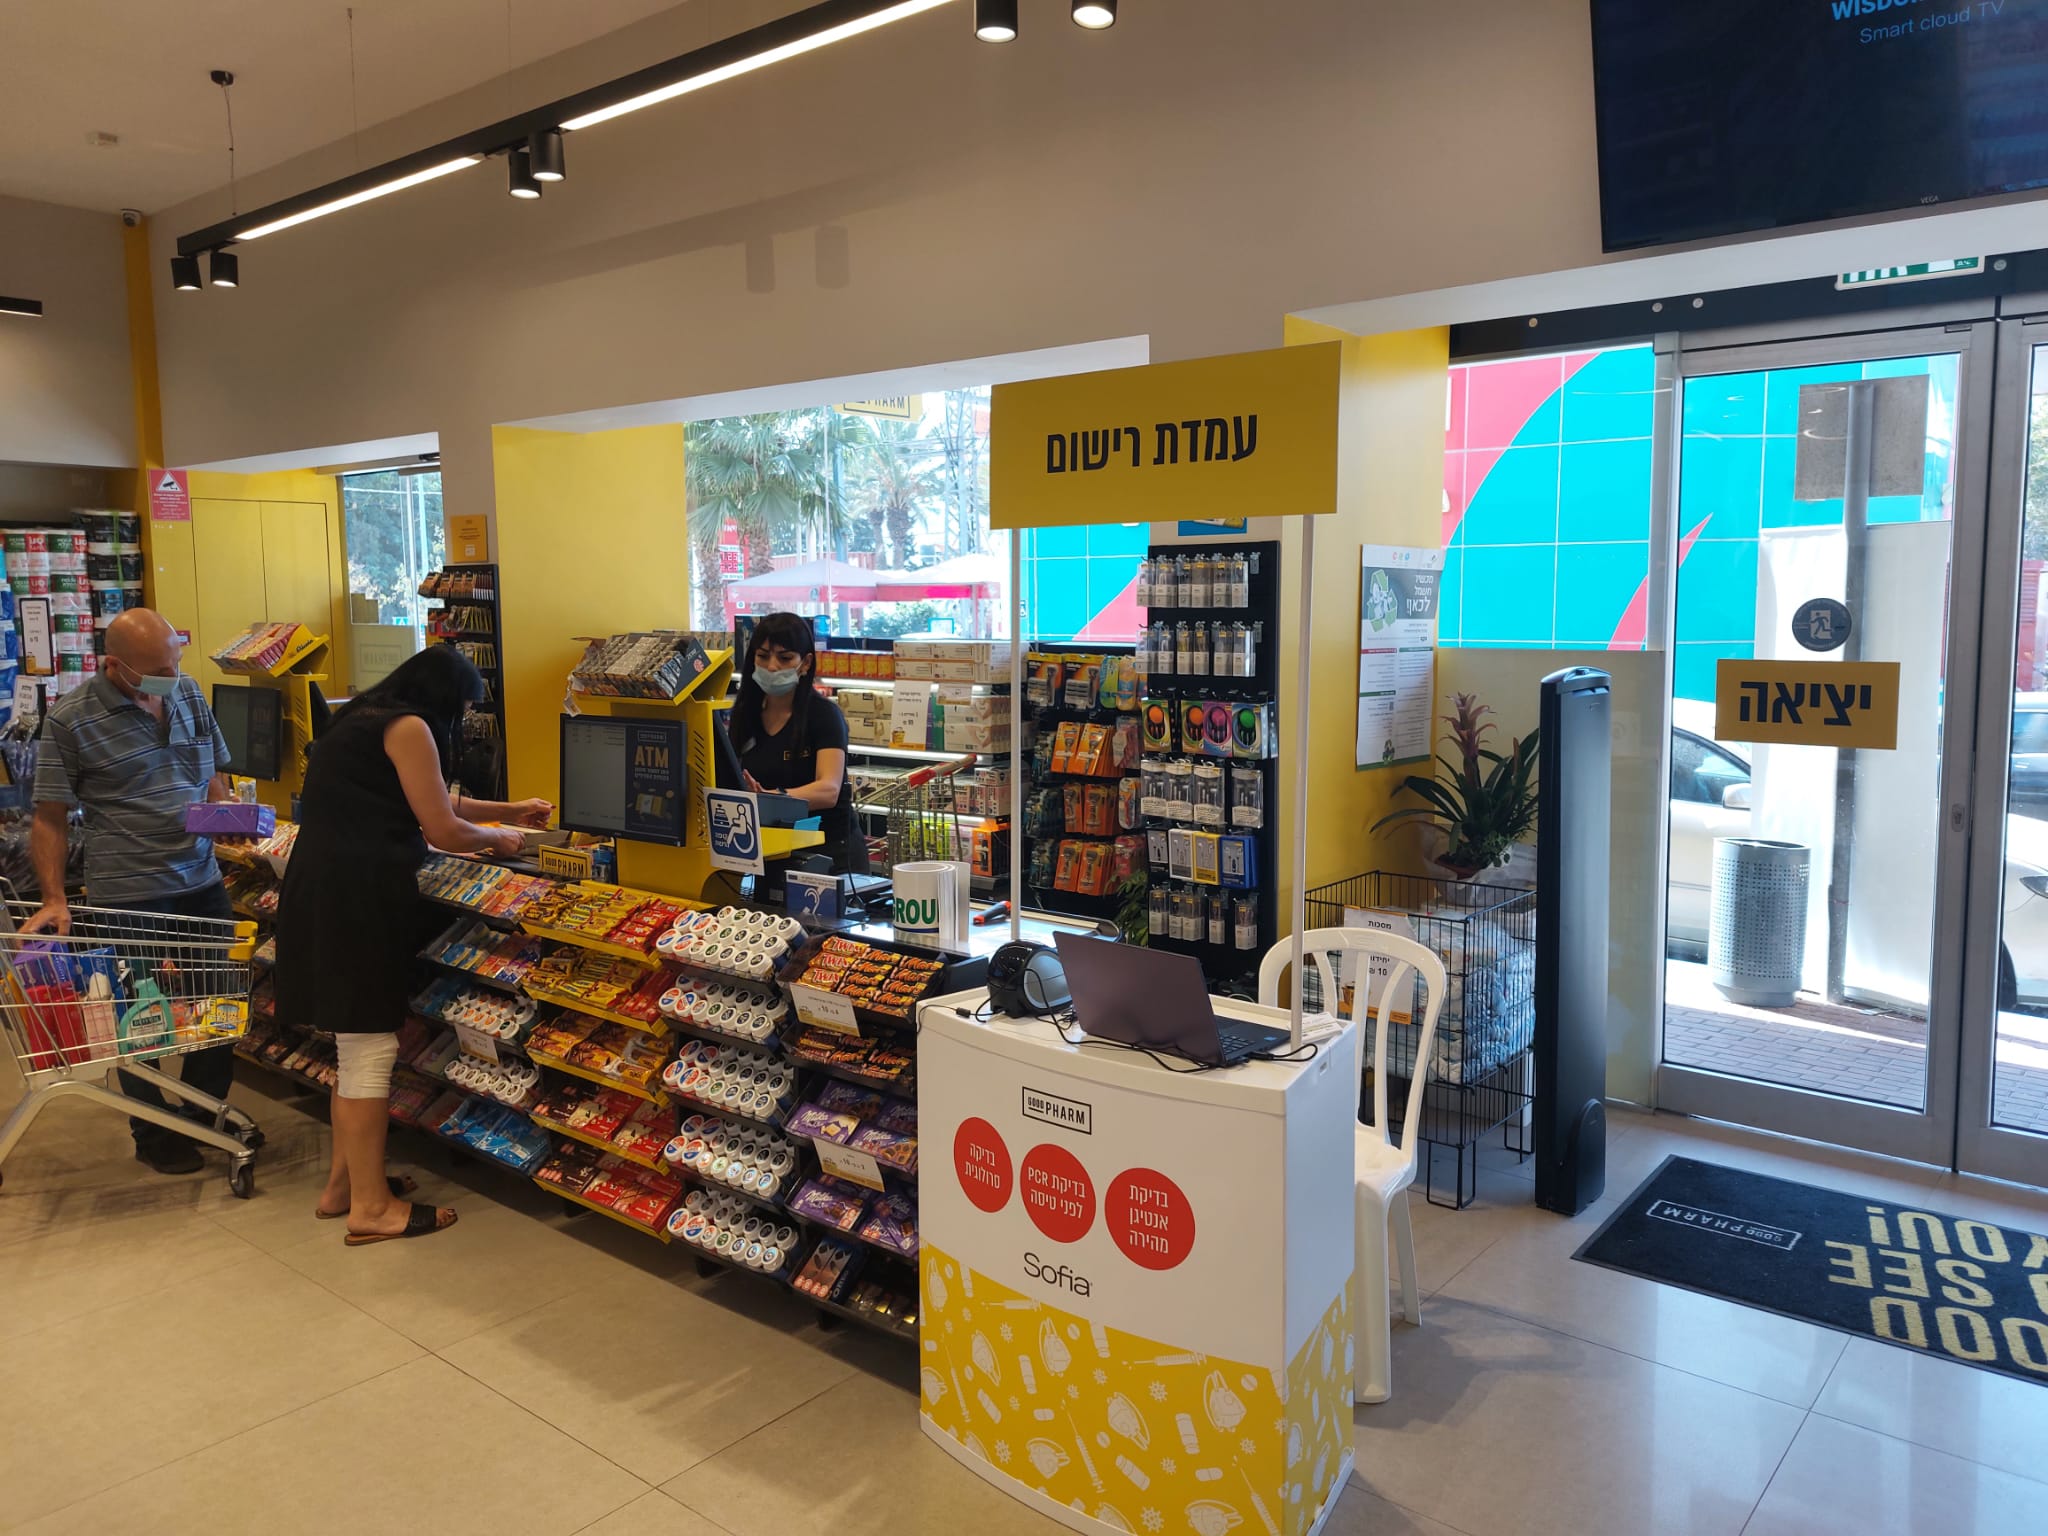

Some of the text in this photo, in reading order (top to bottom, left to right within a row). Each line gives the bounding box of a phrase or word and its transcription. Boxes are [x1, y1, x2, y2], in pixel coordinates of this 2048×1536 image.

[1860, 1, 2003, 43] Smart cloud TV
[1047, 414, 1257, 473] עמדת רישום
[1406, 596, 1431, 616] לכאן!
[1739, 681, 1872, 726] יציאה
[635, 745, 669, 768] ATM
[557, 858, 584, 878] PHARM
[1368, 920, 1392, 930] מסכות
[1378, 967, 1387, 976] 10
[801, 1110, 829, 1122] Milka
[1045, 1101, 1085, 1125] PHARM
[863, 1129, 892, 1141] Milka
[969, 1143, 995, 1166] בדיקה
[965, 1161, 1001, 1189] סרולוגית
[1028, 1166, 1086, 1198] בדיקת PCR
[805, 1189, 834, 1203] Milka
[1030, 1188, 1084, 1219] לפני טיסה
[1129, 1184, 1169, 1208] בדיקת
[1129, 1207, 1169, 1231] אנטיגן
[1663, 1206, 1745, 1233] PHARM
[1129, 1230, 1169, 1254] מהירה
[1023, 1252, 1091, 1297] Sofia
[1825, 1240, 1995, 1307] SEE
